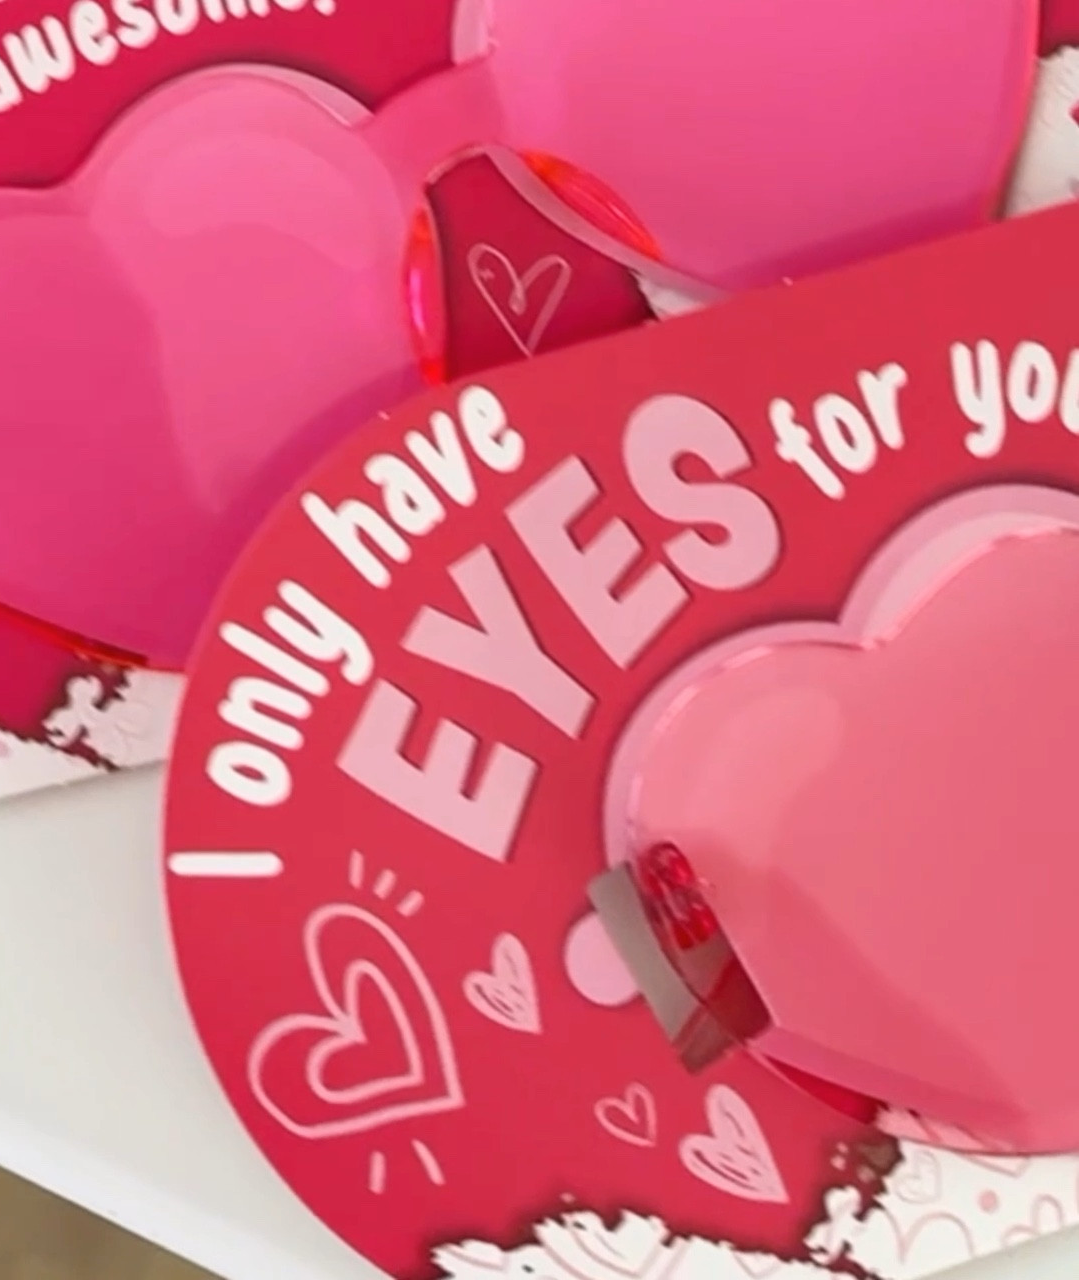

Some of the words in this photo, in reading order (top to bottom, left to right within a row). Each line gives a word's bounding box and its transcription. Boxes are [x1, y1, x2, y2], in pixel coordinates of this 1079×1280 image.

[303, 387, 523, 586] have
[208, 582, 372, 805] only
[338, 395, 778, 861] EYES
[771, 364, 905, 497] for
[167, 851, 283, 878] I
